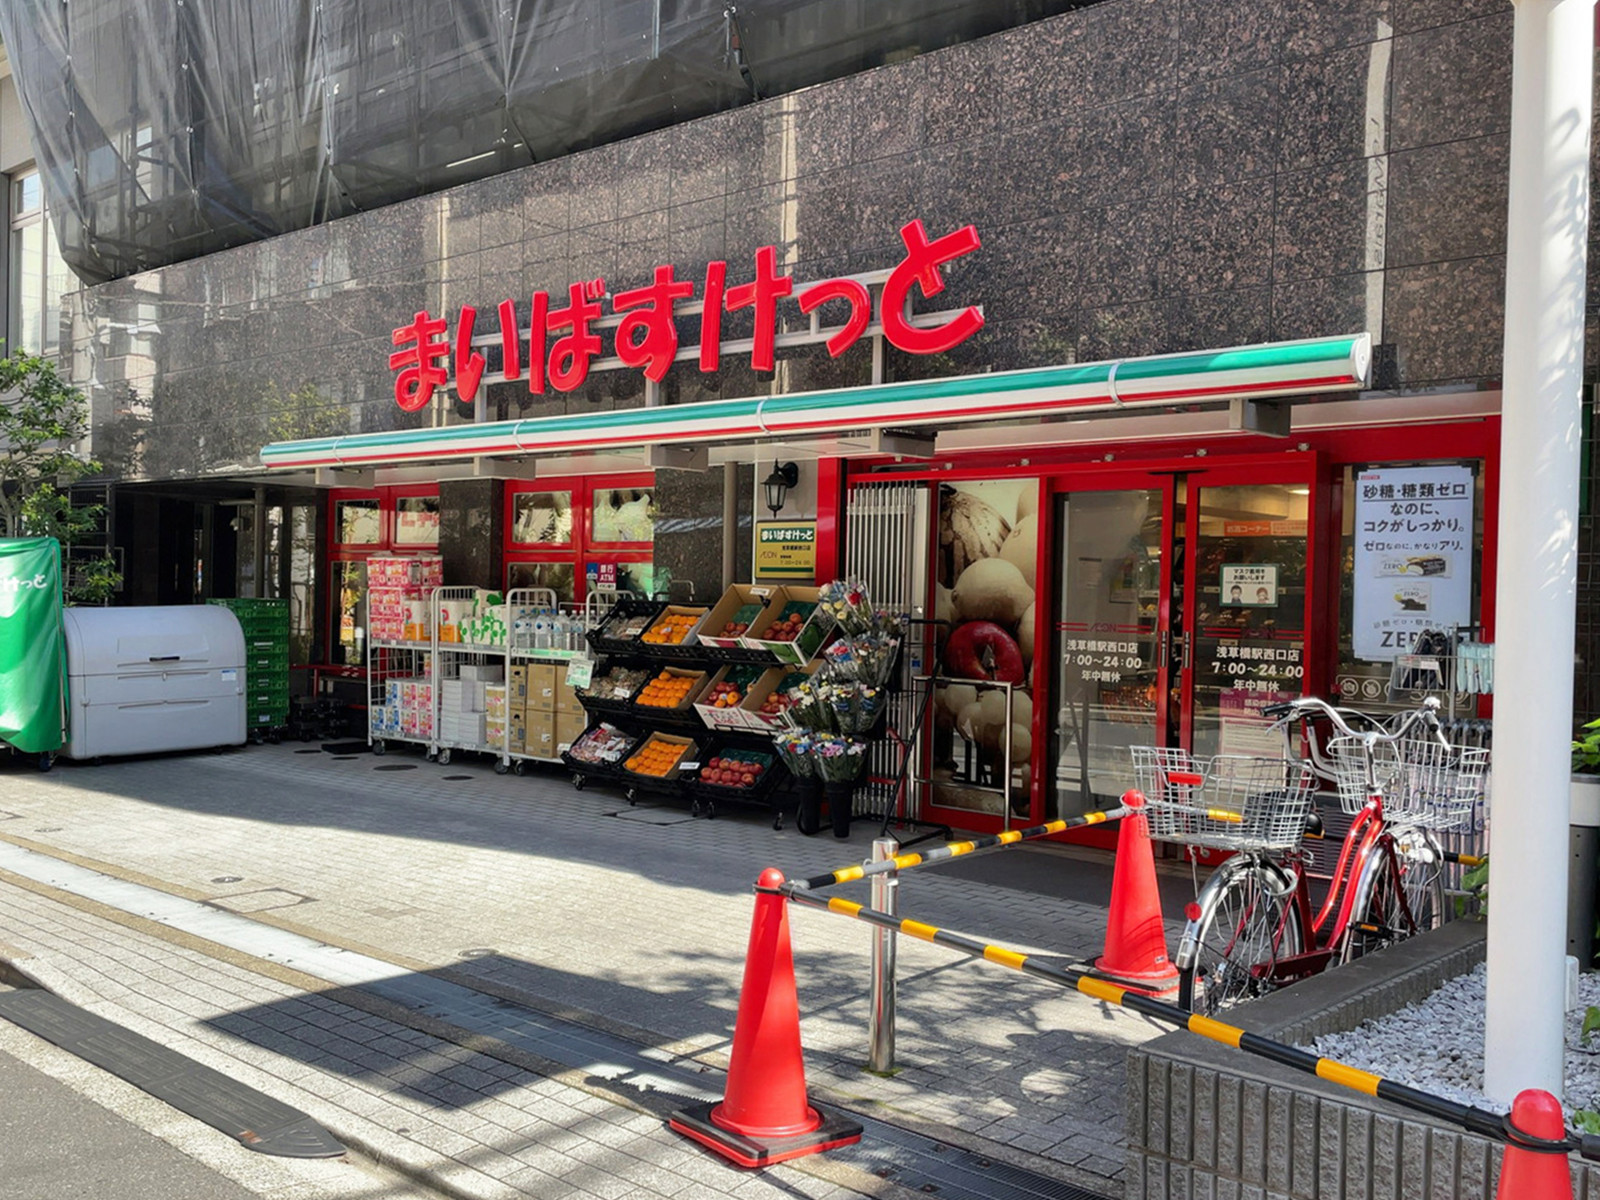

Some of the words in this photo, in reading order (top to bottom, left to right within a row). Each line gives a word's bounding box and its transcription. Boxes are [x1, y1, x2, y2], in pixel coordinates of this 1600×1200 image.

[388, 218, 986, 413] まいばすけっと
[1390, 502, 1440, 516] なのに、
[1363, 517, 1465, 533] コクがしっかり。
[761, 529, 814, 541] まいばすけっと
[599, 574, 614, 582] ATM
[1066, 639, 1139, 654] 浅草橋駅西口店
[1216, 645, 1300, 662] 浅草橋駅西口店
[1081, 669, 1122, 683] 年中無休
[1233, 678, 1280, 694] 年中無休
